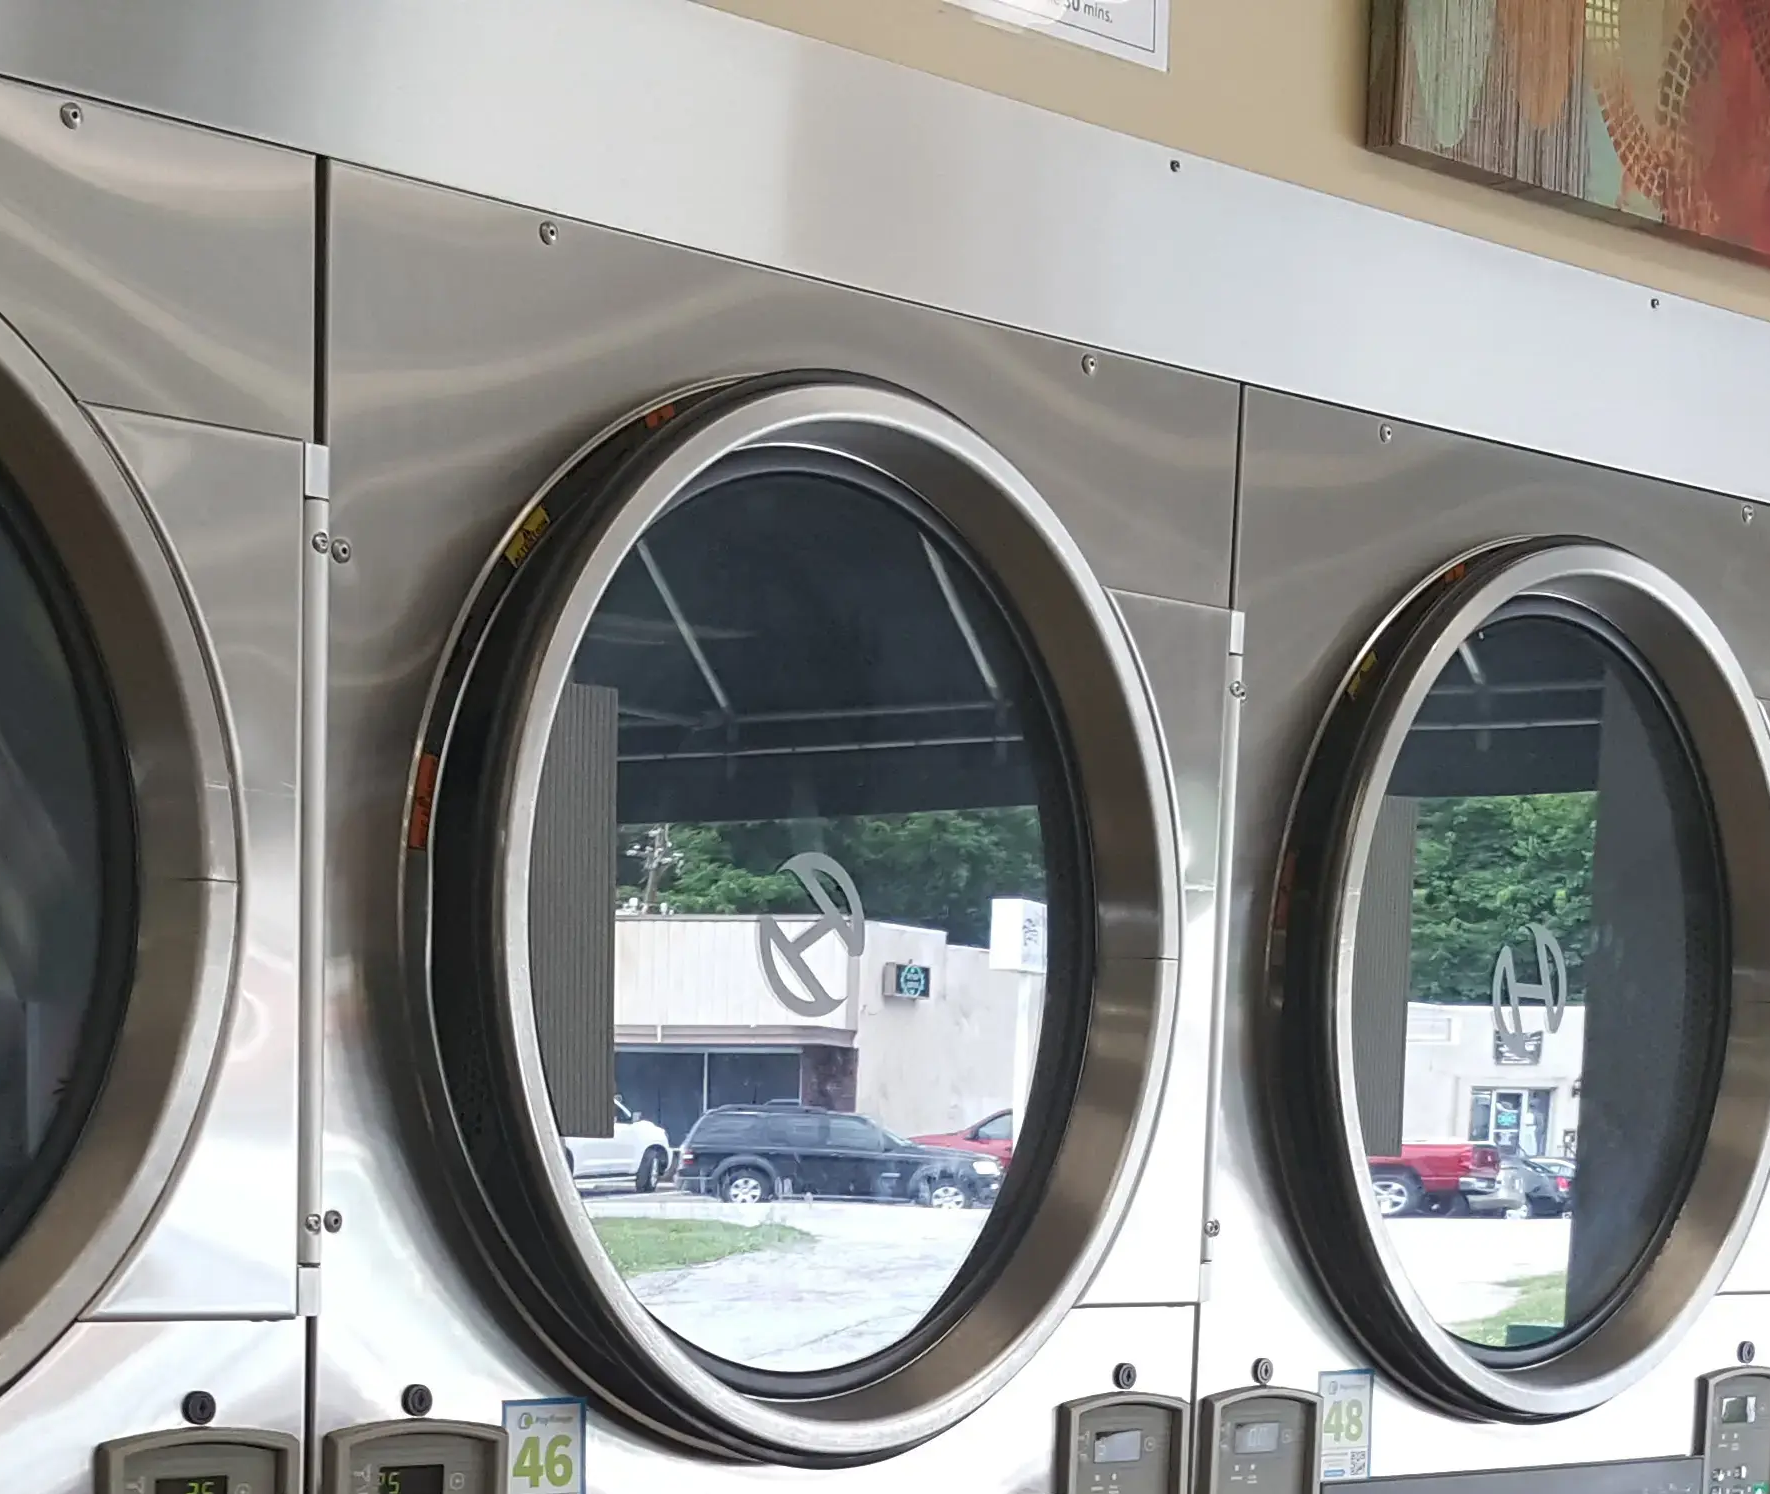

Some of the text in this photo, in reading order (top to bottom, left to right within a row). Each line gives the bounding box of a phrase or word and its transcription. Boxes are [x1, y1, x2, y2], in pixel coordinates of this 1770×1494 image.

[1084, 2, 1113, 23] mins.
[1324, 1398, 1363, 1442] 48
[512, 1434, 573, 1488] 46
